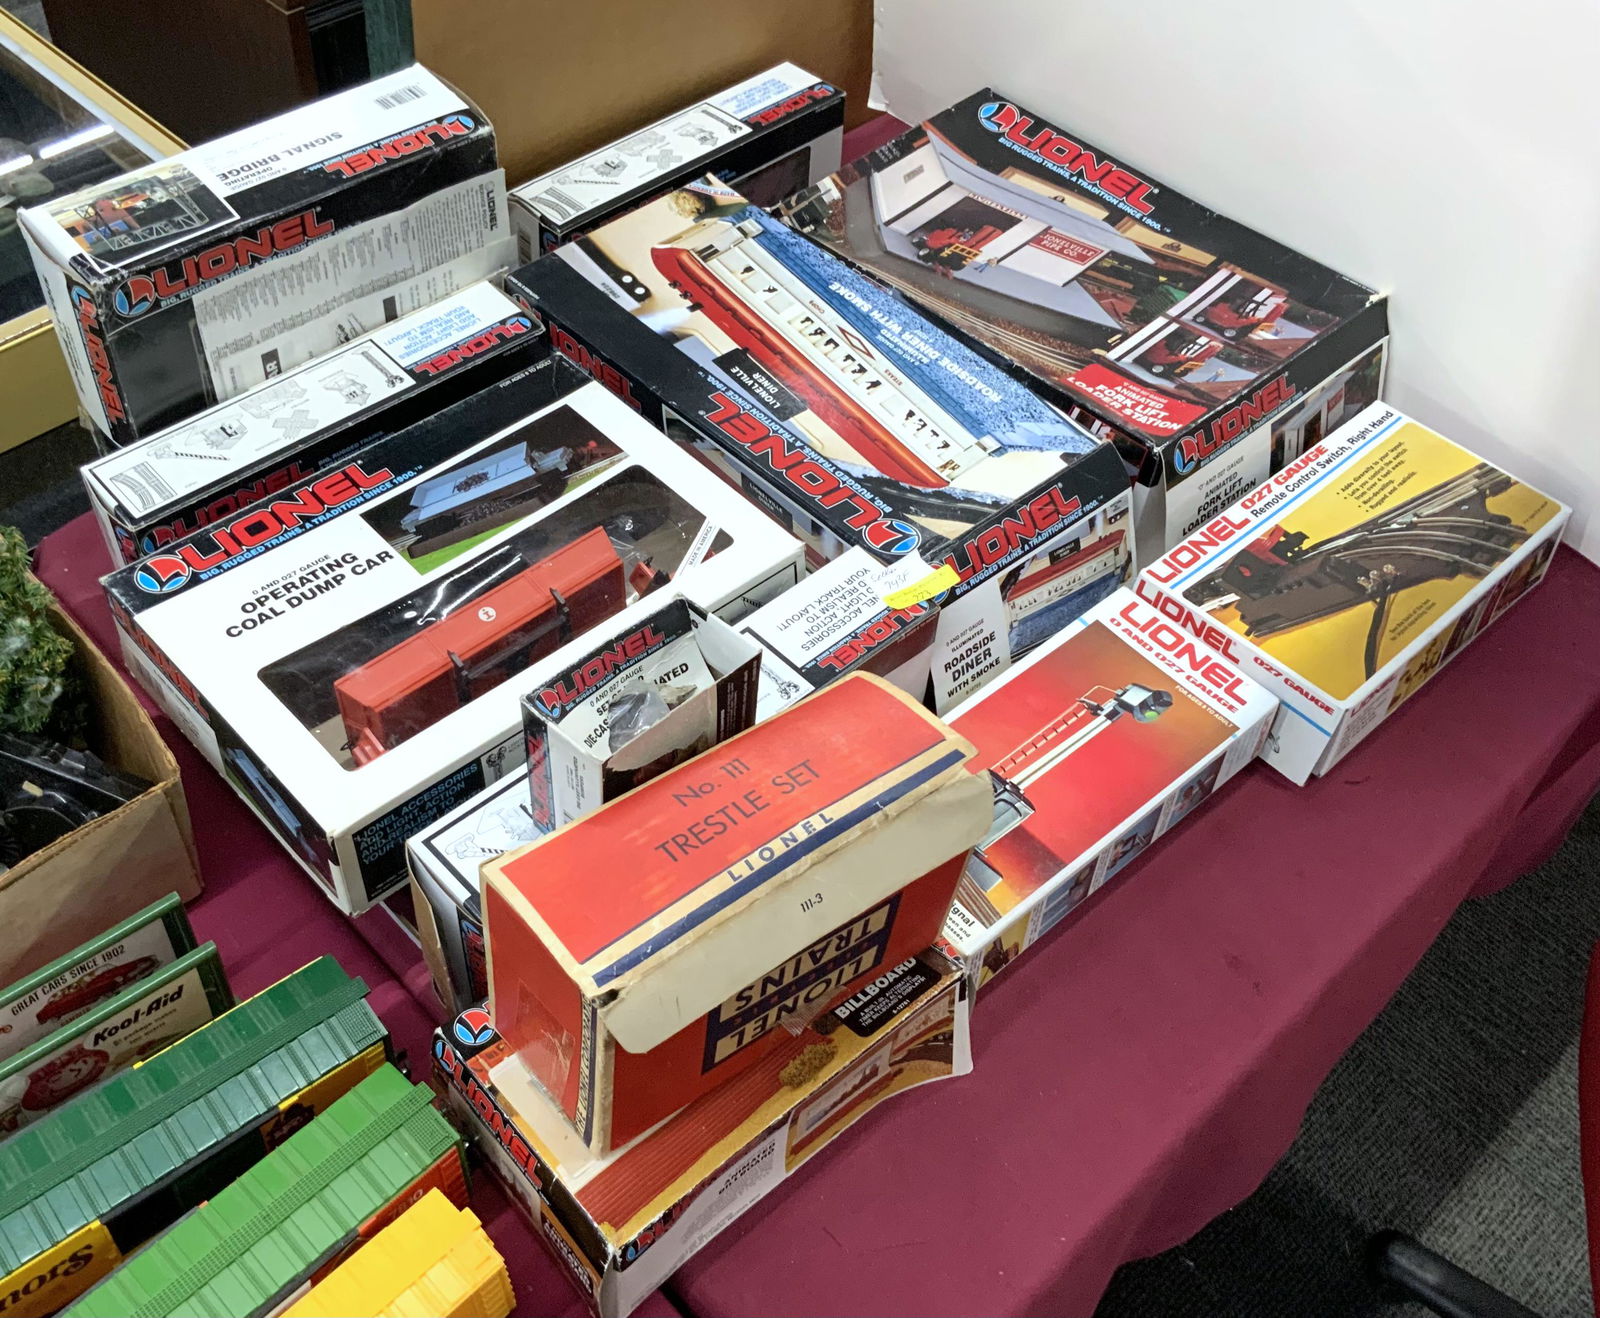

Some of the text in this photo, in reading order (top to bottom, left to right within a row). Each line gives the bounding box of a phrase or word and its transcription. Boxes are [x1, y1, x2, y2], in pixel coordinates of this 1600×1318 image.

[216, 132, 343, 182] SIGNAL BRIDGE
[324, 124, 454, 178] LIONEL
[1005, 114, 1155, 215] LIONEL
[223, 166, 274, 187] OPERATING
[1011, 143, 1042, 165] RUGGED
[1069, 175, 1076, 184] A
[1076, 179, 1117, 206] TRADITION
[1117, 202, 1142, 220] SINCE
[485, 188, 498, 232] LIONEL
[149, 207, 335, 299] LIONEL
[181, 279, 216, 299] RUGGED
[397, 318, 482, 360] LIONEL ACCESSORIES
[417, 306, 465, 331] YOUR TRACK
[419, 317, 453, 337] REALISM
[402, 333, 432, 350] ACTION
[414, 322, 517, 374] LIONEL
[827, 280, 1004, 403] ROADSIDE DINER WITH SMOKE
[881, 329, 929, 362] ILLUMINATED
[78, 312, 126, 424] LIONEL
[500, 379, 510, 387] FOR
[511, 372, 525, 382] AGES
[536, 360, 552, 370] ADULT
[730, 366, 781, 409] LIONELVILLE
[752, 372, 779, 394] DINER
[725, 390, 752, 411] SINCE
[1066, 376, 1183, 430] LOADER STATION
[1095, 384, 1170, 418] FORK LIFT
[1114, 384, 1164, 409] ANIMATED
[1196, 375, 1296, 460] LIONEL
[750, 408, 795, 442] TRADITION
[792, 438, 803, 448] A
[705, 391, 884, 530] LIONEL
[1249, 408, 1395, 520] Remote Control Switch, Right Hand
[1273, 443, 1329, 488] GAUGE
[171, 462, 314, 538] LIONEL
[834, 469, 874, 500] RUGGED
[870, 496, 892, 513] BIG,
[1181, 478, 1257, 535] LOADER STATION
[1196, 478, 1242, 515] FORK LIFT
[1204, 471, 1238, 498] ANIMATED
[178, 462, 394, 572] LIONEL
[199, 565, 223, 581] BIG,
[221, 543, 266, 570] RUGGED
[303, 519, 314, 529] A
[312, 496, 361, 525] TRADITION
[359, 481, 392, 502] SINCE
[944, 485, 1081, 582] LIONEL
[688, 551, 698, 565] MADE
[699, 525, 713, 546] AMERICA
[955, 582, 970, 595] BIG,
[969, 564, 999, 586] RUGGED
[1023, 543, 1031, 551] A
[1029, 521, 1065, 547] TRADITION
[1063, 510, 1082, 525] SINCE
[1146, 515, 1252, 583] LIONEL
[226, 550, 395, 638] COAL DUMP CAR
[240, 552, 359, 615] OPERATING
[259, 554, 331, 591] AND GAUGE
[814, 582, 846, 607] TRACK
[845, 565, 871, 587] YOUR
[776, 602, 815, 633] LAYOUT!
[805, 609, 821, 626] TO
[818, 583, 859, 617] REALISM
[1135, 578, 1240, 664] LIONEL
[800, 606, 864, 652] ACCESSORIES
[803, 610, 838, 638] ACTION
[817, 607, 916, 670] LIONEL
[949, 619, 984, 644] AND GAUGE
[951, 628, 984, 652] ILLUMINATED
[553, 625, 666, 705] LIONEL
[943, 630, 997, 672] ROADSIDE
[951, 646, 993, 682] DINER
[1118, 601, 1248, 706] LIONEL
[1120, 624, 1240, 715] AND GAUGE
[594, 688, 608, 703] AND
[619, 663, 644, 685] GAUGE
[946, 656, 1001, 697] WITH SMOKE
[1282, 676, 1335, 715] GAUGE
[1174, 685, 1187, 696] FOR
[1185, 692, 1203, 707] AGES
[1205, 705, 1216, 715] TO
[1213, 710, 1235, 728] ADULT
[399, 762, 478, 816] ACCESSORIES
[424, 779, 466, 810] ACTION
[654, 759, 821, 862] TRESTLE SET
[672, 782, 722, 808] No.
[384, 806, 437, 844] REALISM
[439, 795, 455, 810] TO
[728, 812, 834, 882] LIONEL
[959, 928, 970, 938] and
[9, 943, 126, 1017] GREAT CARS SINCE 1902
[735, 916, 873, 1012] TRAINS
[730, 955, 862, 1048] LIONEL
[832, 956, 918, 1020] BILLBOARD
[92, 985, 184, 1048] Kool-Aid
[578, 1066, 590, 1111] LIONEL
[453, 1066, 543, 1190] LIONEL
